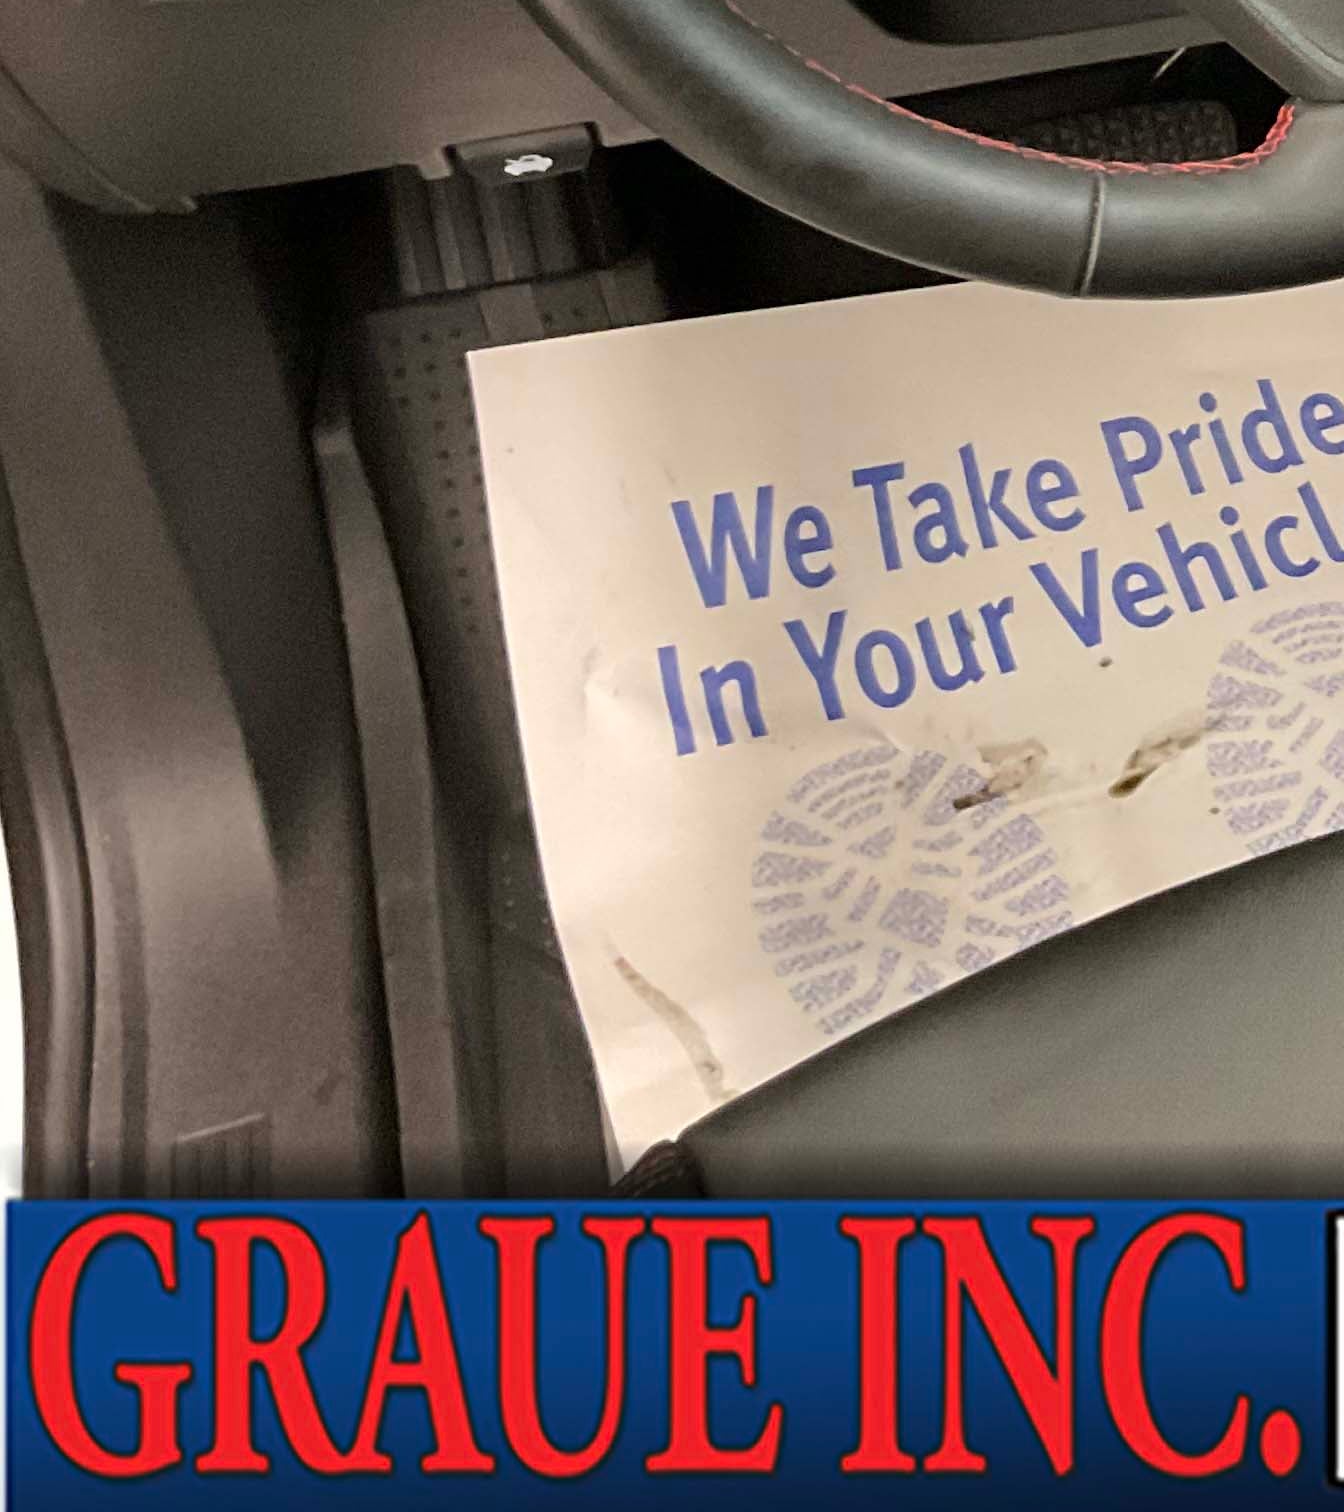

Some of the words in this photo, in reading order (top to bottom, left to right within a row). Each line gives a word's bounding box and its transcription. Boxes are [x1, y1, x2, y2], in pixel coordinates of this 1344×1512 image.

[672, 485, 835, 608] We
[852, 443, 1085, 572] Take
[658, 644, 769, 755] In
[784, 597, 1014, 722] Your
